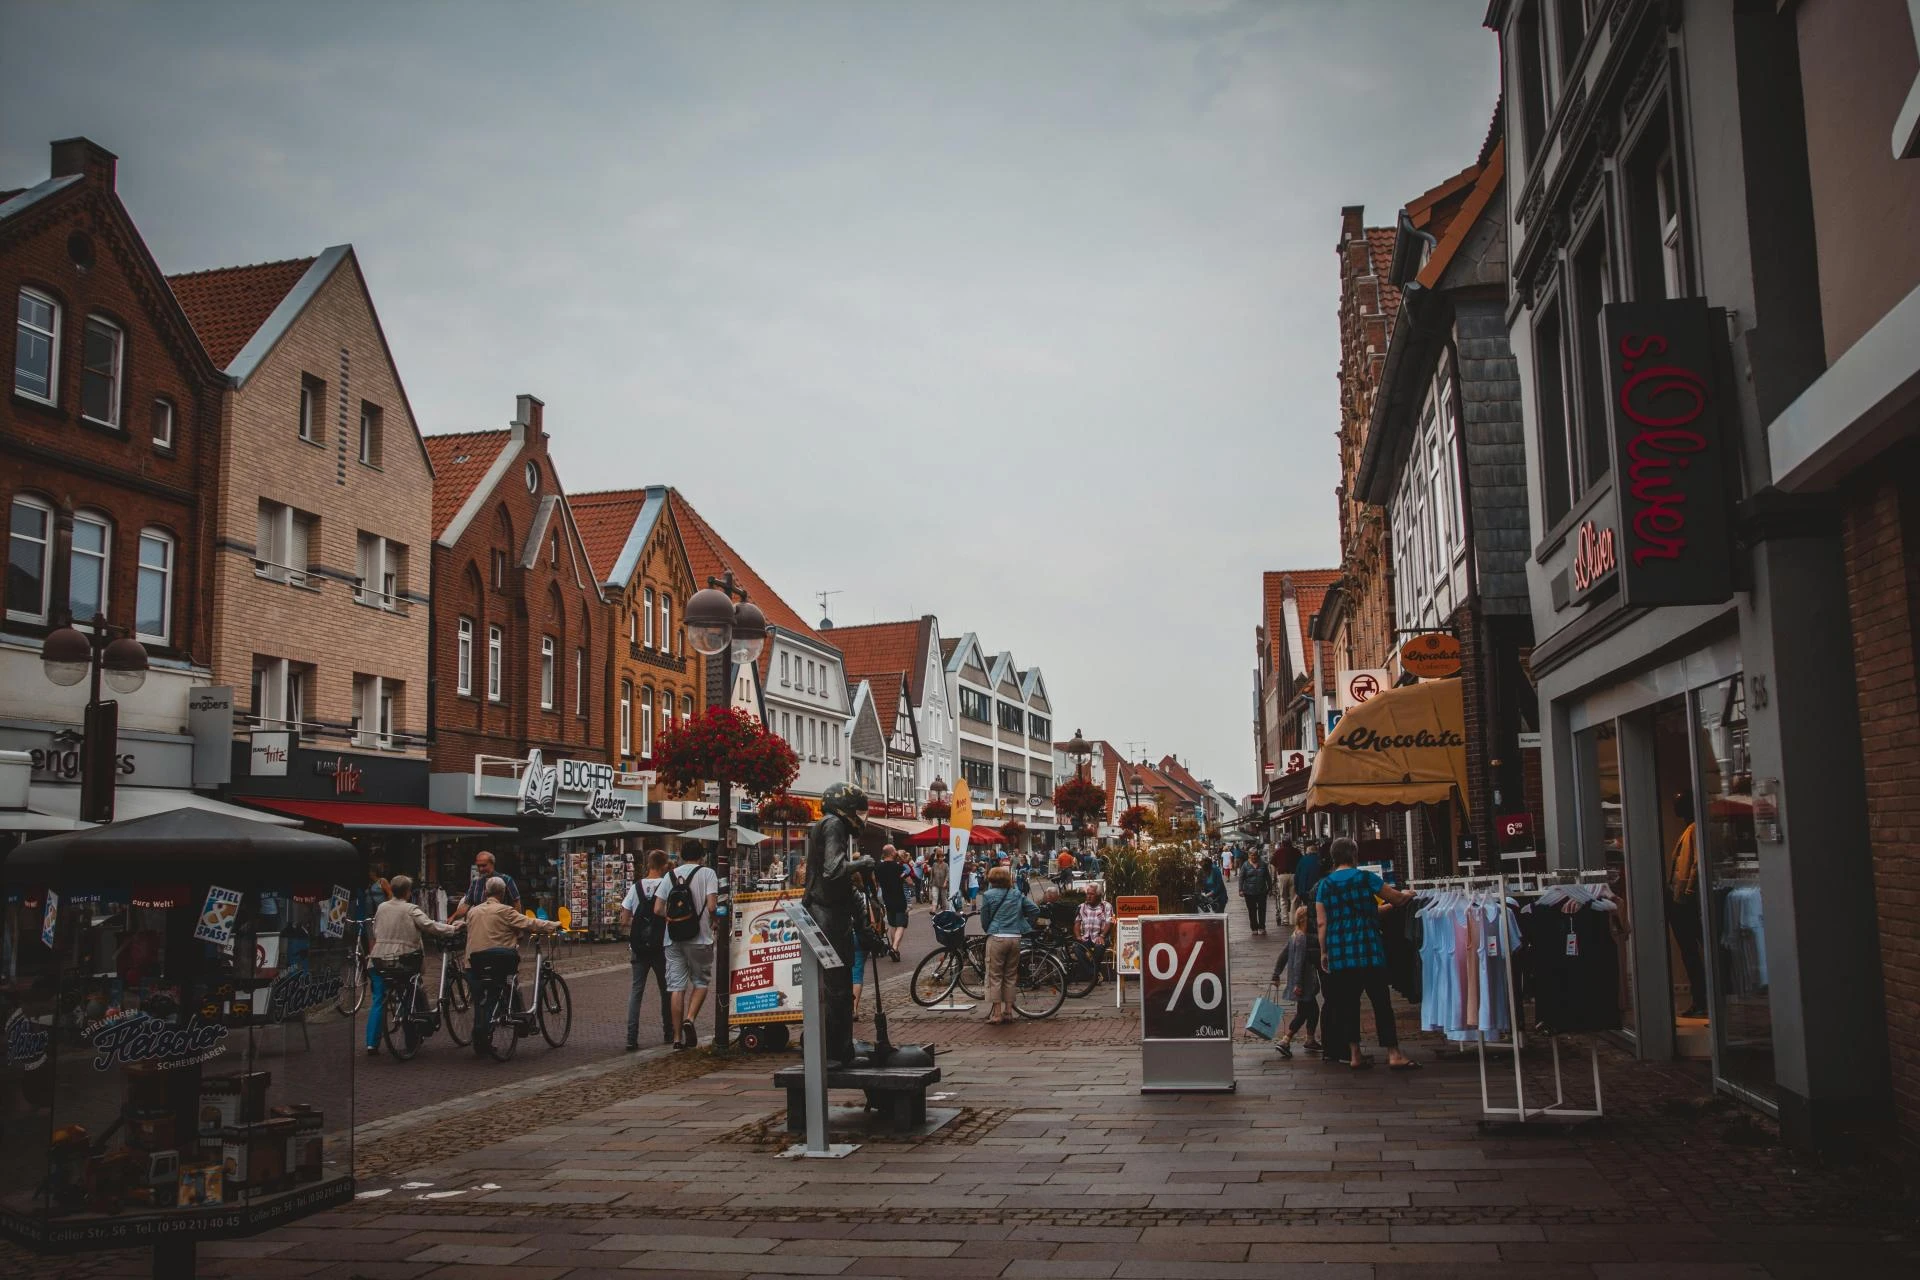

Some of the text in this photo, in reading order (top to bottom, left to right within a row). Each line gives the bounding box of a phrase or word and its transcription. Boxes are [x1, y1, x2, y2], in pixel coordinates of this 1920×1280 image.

[1619, 333, 1712, 570] s.Oliver
[1574, 521, 1616, 592] s.Oliver
[189, 700, 229, 711] engbers
[1339, 727, 1465, 752] Chocolata
[564, 760, 613, 790] BÜCHER
[592, 789, 626, 816] Leseberg
[153, 899, 174, 908] Welt!
[210, 888, 239, 903] SPIEL
[334, 886, 350, 900] SPIEL
[196, 926, 228, 941] SPASS
[770, 920, 796, 930] CAS
[1148, 941, 1223, 1012] %
[80, 1008, 138, 1039] SPIELWAREN
[1195, 1025, 1224, 1037] s.Oliver
[157, 1045, 226, 1071] SCHREIBWAREN
[88, 1227, 109, 1239] Str.
[112, 1226, 126, 1236] 56
[135, 1223, 153, 1235] Tel.
[157, 1221, 169, 1233] (0
[172, 1220, 187, 1231] 50
[188, 1218, 207, 1231] 21)
[209, 1217, 224, 1228] 40
[226, 1216, 240, 1226] 45
